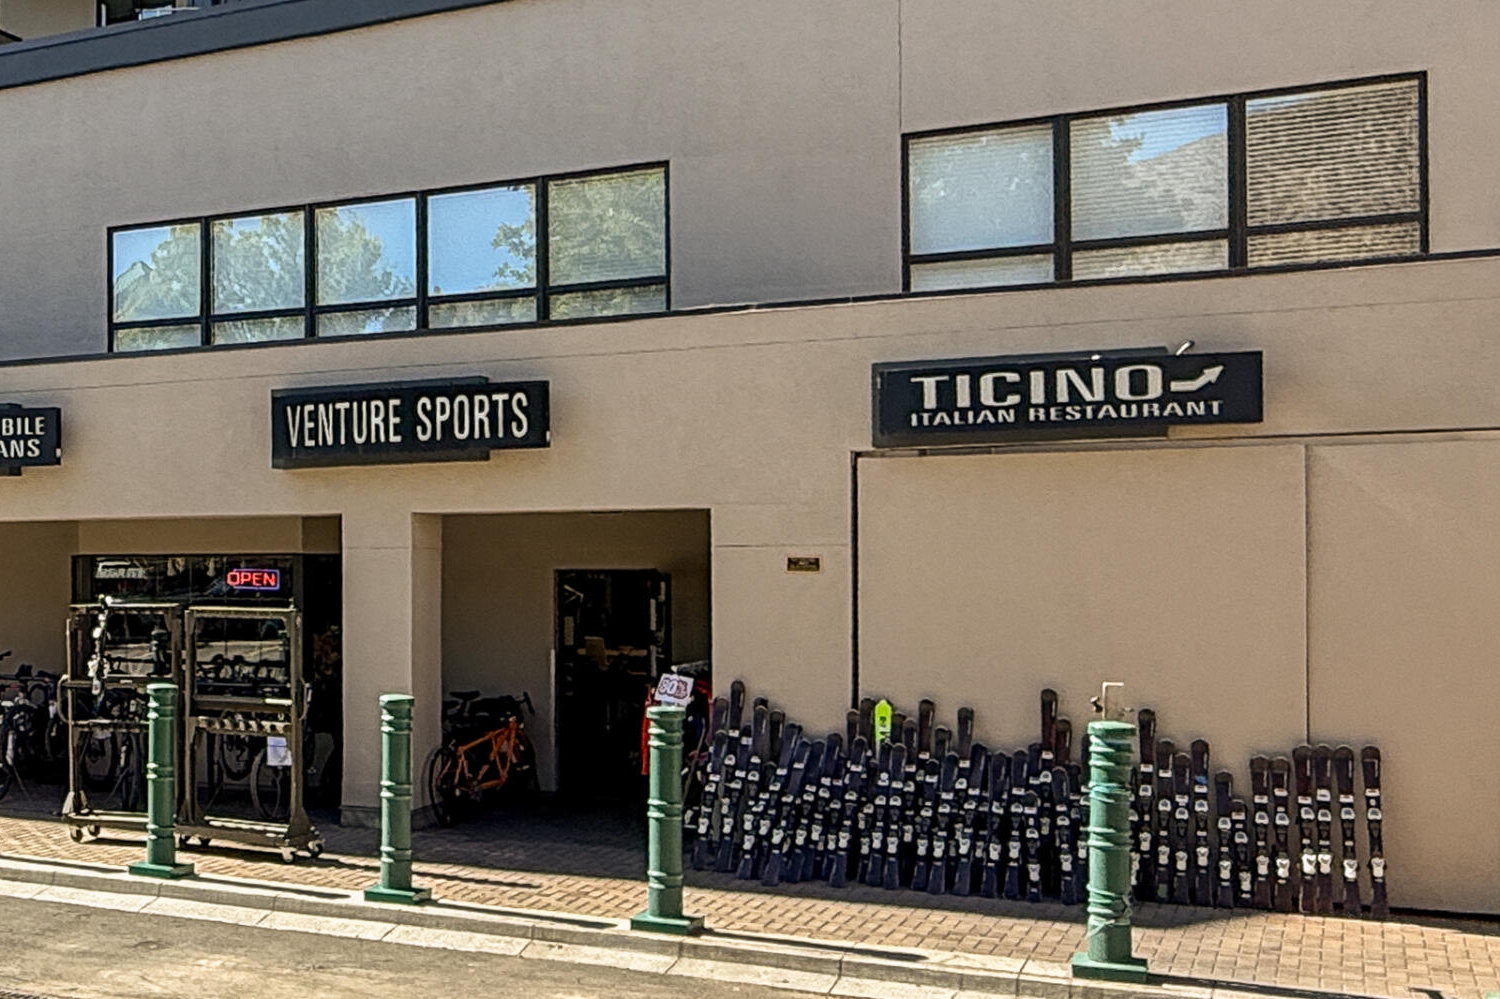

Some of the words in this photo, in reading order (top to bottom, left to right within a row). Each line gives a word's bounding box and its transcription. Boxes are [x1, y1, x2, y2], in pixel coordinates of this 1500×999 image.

[910, 364, 1164, 410] TICINO
[286, 399, 402, 448] VENTURE
[416, 392, 528, 442] SPORTS
[910, 408, 1016, 428] ITALIAN
[1028, 400, 1224, 423] RESTAURANT
[227, 570, 277, 588] OPEN
